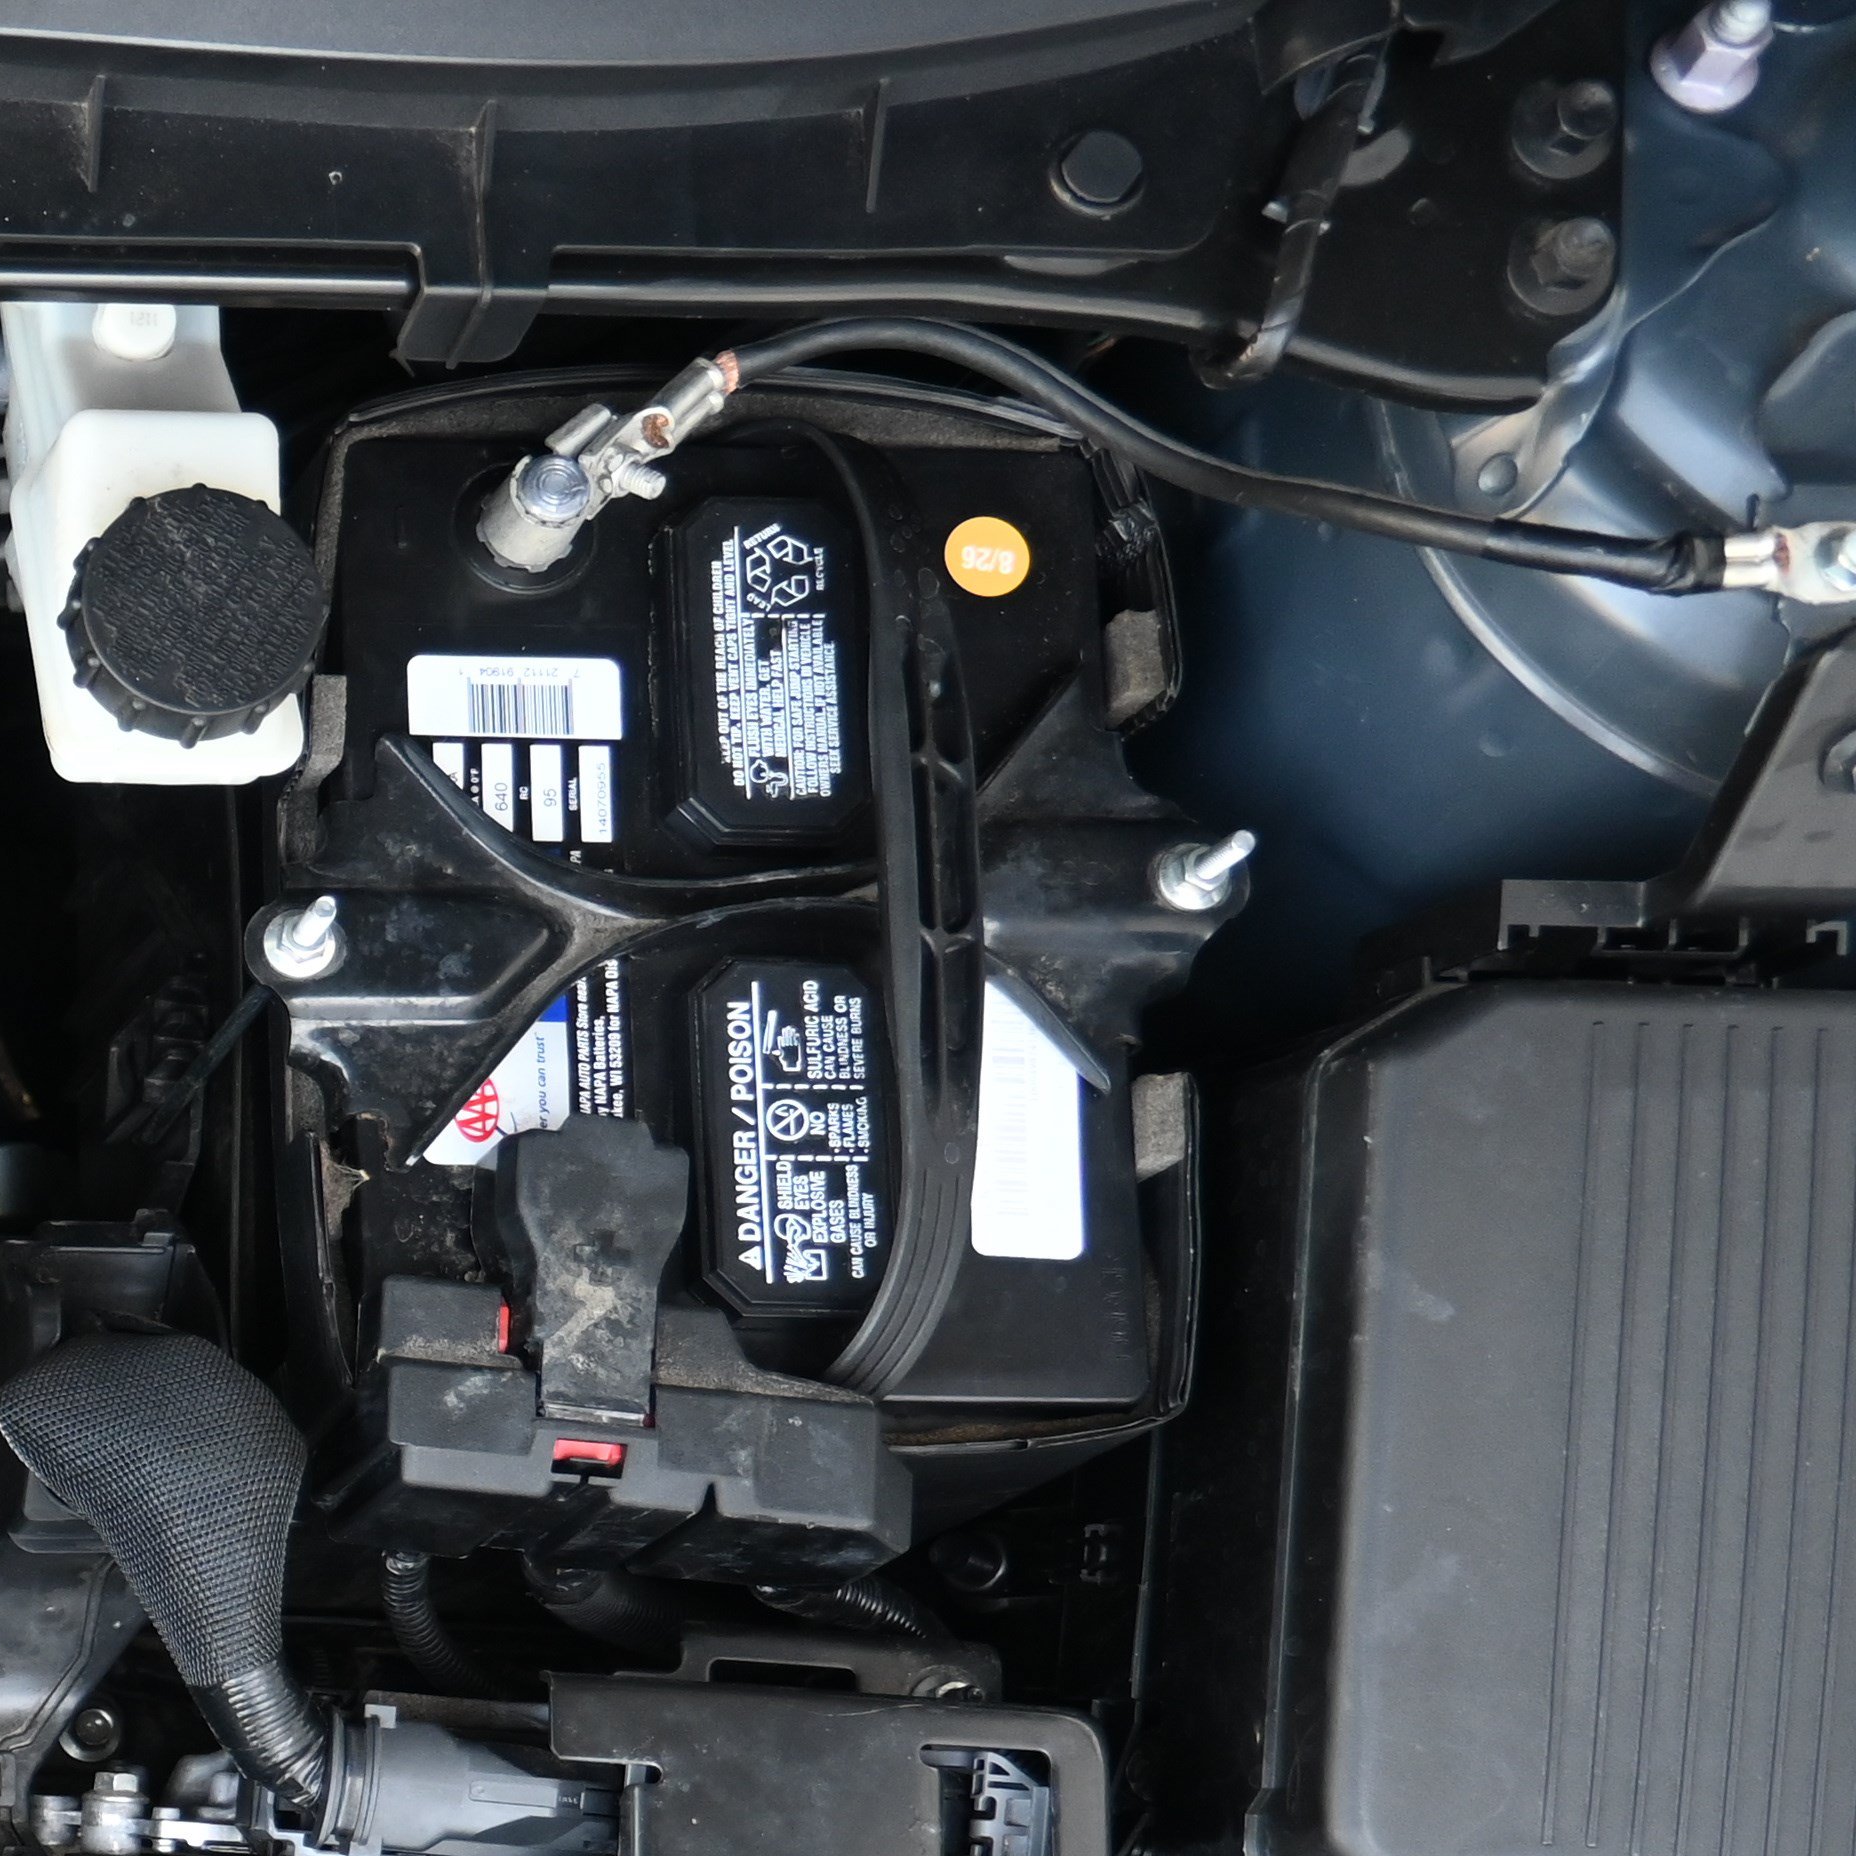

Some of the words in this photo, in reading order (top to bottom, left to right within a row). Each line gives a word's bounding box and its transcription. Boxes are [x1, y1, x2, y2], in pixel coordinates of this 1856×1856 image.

[722, 539, 734, 571] LEVEL
[814, 547, 824, 591] RECYCLE
[961, 545, 1016, 575] 8/26
[711, 560, 723, 614] CHILDREN
[724, 574, 735, 596] AND
[724, 599, 736, 631] TIGHT
[746, 592, 771, 611] LEAD
[713, 616, 724, 631] OF
[715, 634, 726, 669] REACH
[726, 633, 738, 660] CAPS
[742, 618, 757, 690] IMMEDIATELY
[787, 620, 800, 670] STARTING
[800, 624, 811, 664] VEHICLE
[811, 620, 824, 674] AVAILABLE
[728, 663, 739, 691] VENT
[758, 659, 770, 681] GET
[770, 649, 782, 677] FAST
[824, 640, 838, 704] ASSISTANCE.
[716, 672, 727, 693] THE
[771, 680, 784, 707] HELP
[789, 671, 801, 699] JUMP
[813, 675, 825, 696] NOT
[717, 695, 728, 709] OF
[729, 693, 741, 720] KEEP
[746, 692, 759, 720] EYES
[759, 684, 773, 726] WATER.
[791, 700, 803, 725] SAFE
[801, 678, 816, 751] INSTRUCTIONS
[814, 697, 826, 706] IF
[718, 711, 729, 734] OUT
[731, 723, 742, 744] TIP.
[773, 709, 787, 757] MEDICAL
[792, 727, 804, 747] FOR
[827, 706, 840, 747] SERVICE
[748, 721, 761, 757] FLUSH
[761, 728, 774, 757] WITH
[732, 747, 743, 768] NOT
[794, 749, 807, 796] CAUTION:
[806, 752, 819, 793] FOLLOW
[829, 749, 841, 774] SEEK
[733, 771, 745, 786] DO
[818, 754, 831, 797] OWNERS
[495, 782, 508, 811] 640
[519, 786, 529, 800] RC
[543, 787, 557, 807] 95
[569, 777, 578, 811] SERIAL
[597, 762, 607, 833] 14070955
[606, 981, 619, 1012] NAPA
[803, 980, 819, 1012] ACID
[834, 995, 847, 1013] OR
[575, 1004, 588, 1029] Store
[608, 1015, 620, 1031] for
[849, 997, 862, 1035] BURNS
[576, 1030, 589, 1061] PARTS
[592, 1016, 607, 1069] Batteries,
[804, 1015, 823, 1079] SULFURIC
[822, 1015, 835, 1052] CAUSE
[835, 1017, 851, 1079] BLINDNESS
[608, 1033, 622, 1068] 53209
[727, 1001, 754, 1101] POISON
[852, 1038, 865, 1079] SEVERE
[537, 1068, 546, 1087] can
[577, 1062, 590, 1089] AUTO
[610, 1070, 622, 1086] WI
[824, 1056, 837, 1080] CAN
[538, 1091, 550, 1113] you
[594, 1071, 607, 1104] NAPA
[731, 1107, 755, 1126] /
[809, 1111, 826, 1135] NO
[732, 1131, 762, 1242] DANGER
[775, 1161, 793, 1210] SHIELD
[793, 1175, 810, 1210] EYES
[846, 1164, 861, 1219] BLINDNESS
[809, 1171, 828, 1243] EXPLOSIVE
[829, 1200, 846, 1243] GASES
[862, 1192, 876, 1229] INJURY
[849, 1223, 863, 1255] CAUSE
[864, 1232, 877, 1248] OR
[851, 1257, 865, 1278] CAN
